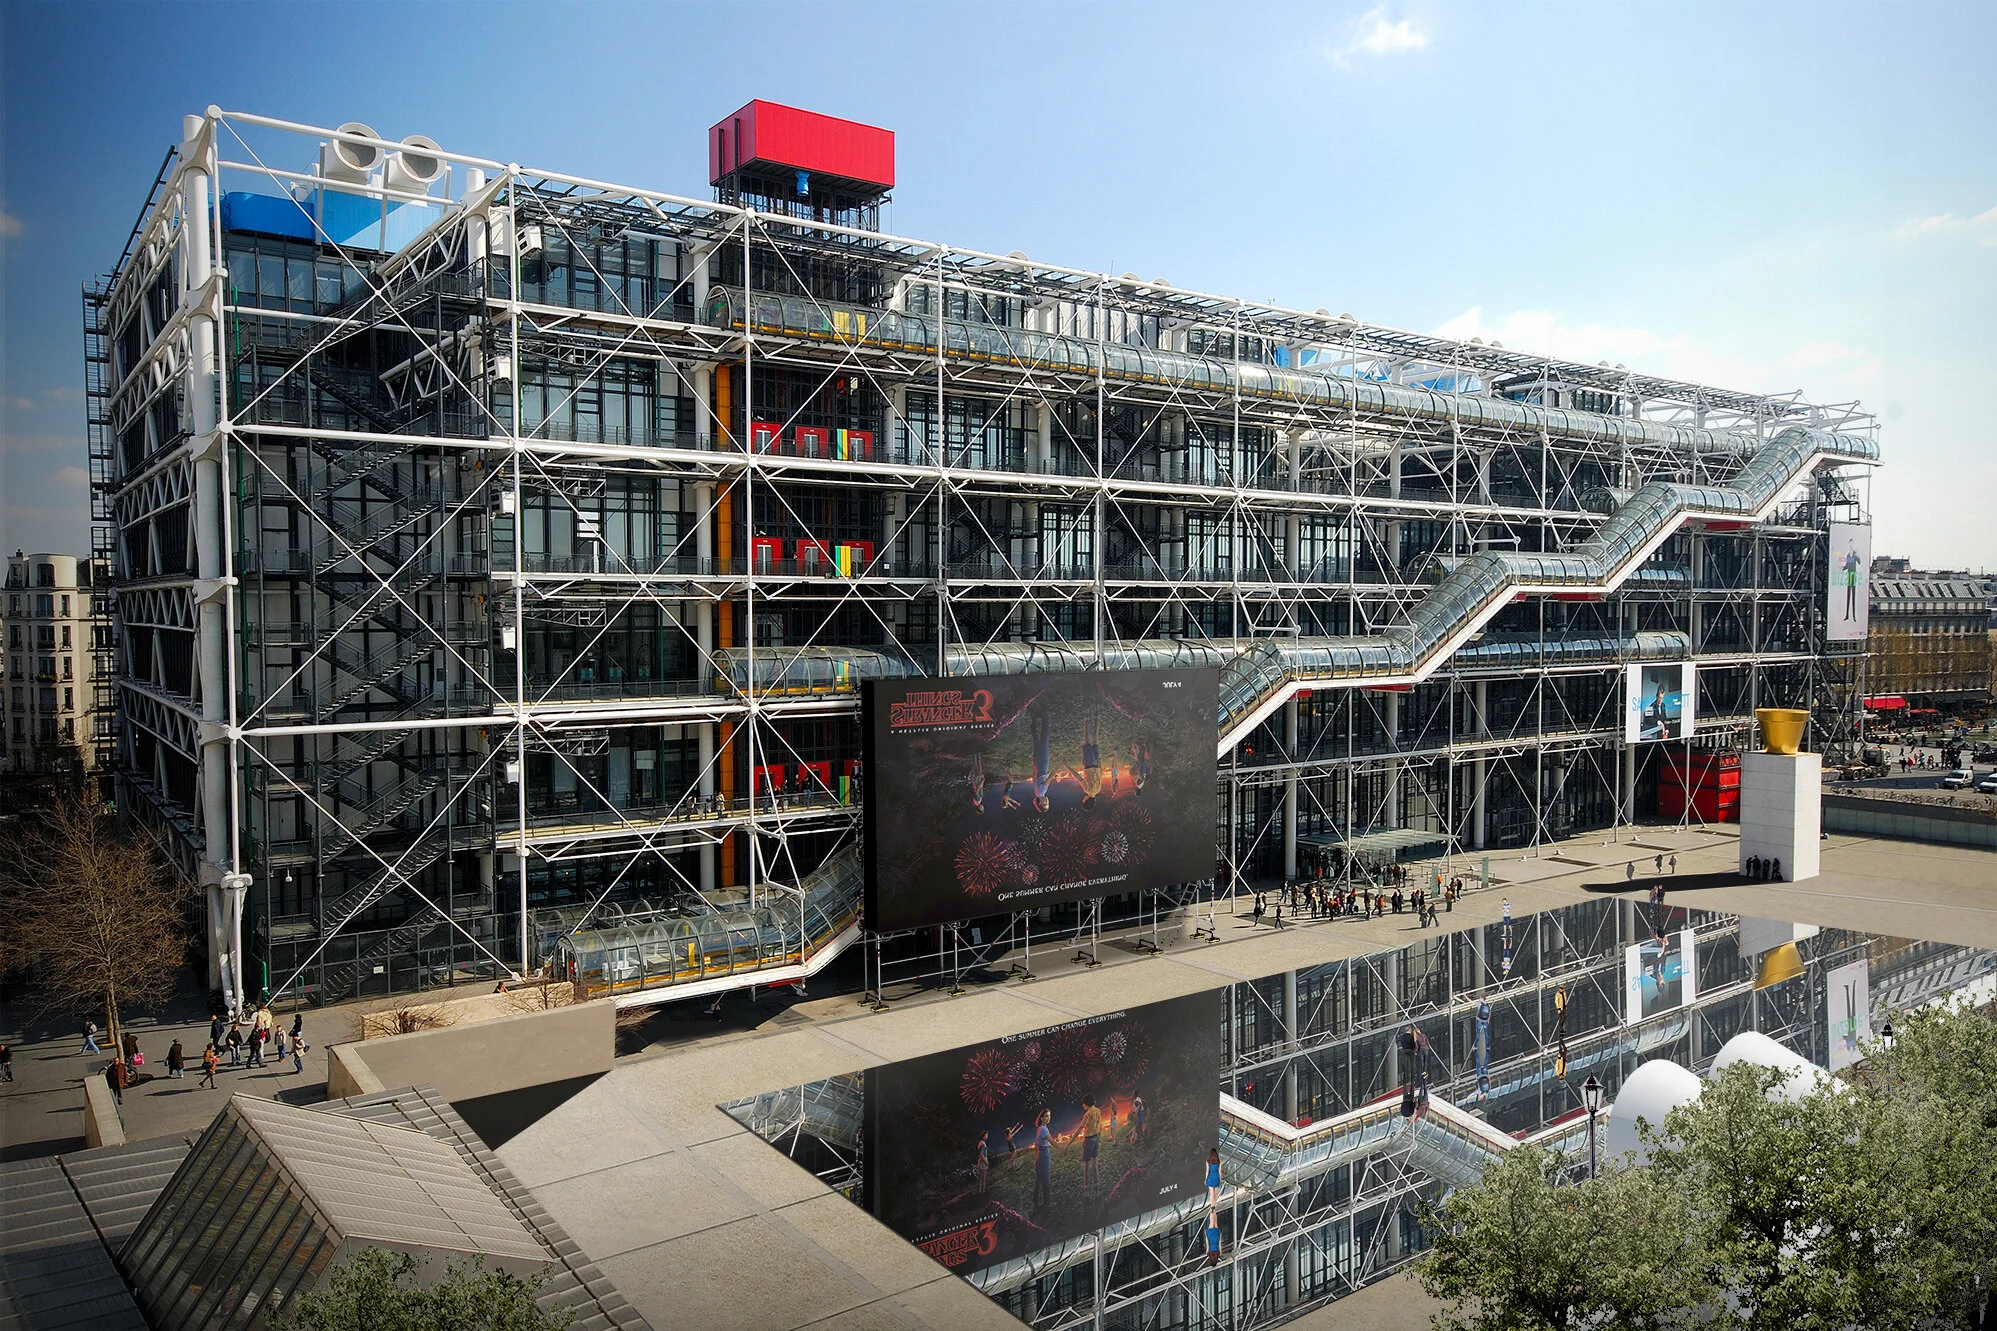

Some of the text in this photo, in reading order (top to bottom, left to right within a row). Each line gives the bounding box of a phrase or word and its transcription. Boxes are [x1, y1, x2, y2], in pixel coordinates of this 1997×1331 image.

[1018, 1030, 1046, 1040] SUMMER
[1046, 1026, 1060, 1034] CAN
[1061, 1020, 1087, 1031] CHANGE
[1159, 1184, 1174, 1195] JULY
[939, 1222, 972, 1234] ORIGINAL
[975, 1212, 998, 1223] SERIES
[977, 1220, 998, 1256] 3
